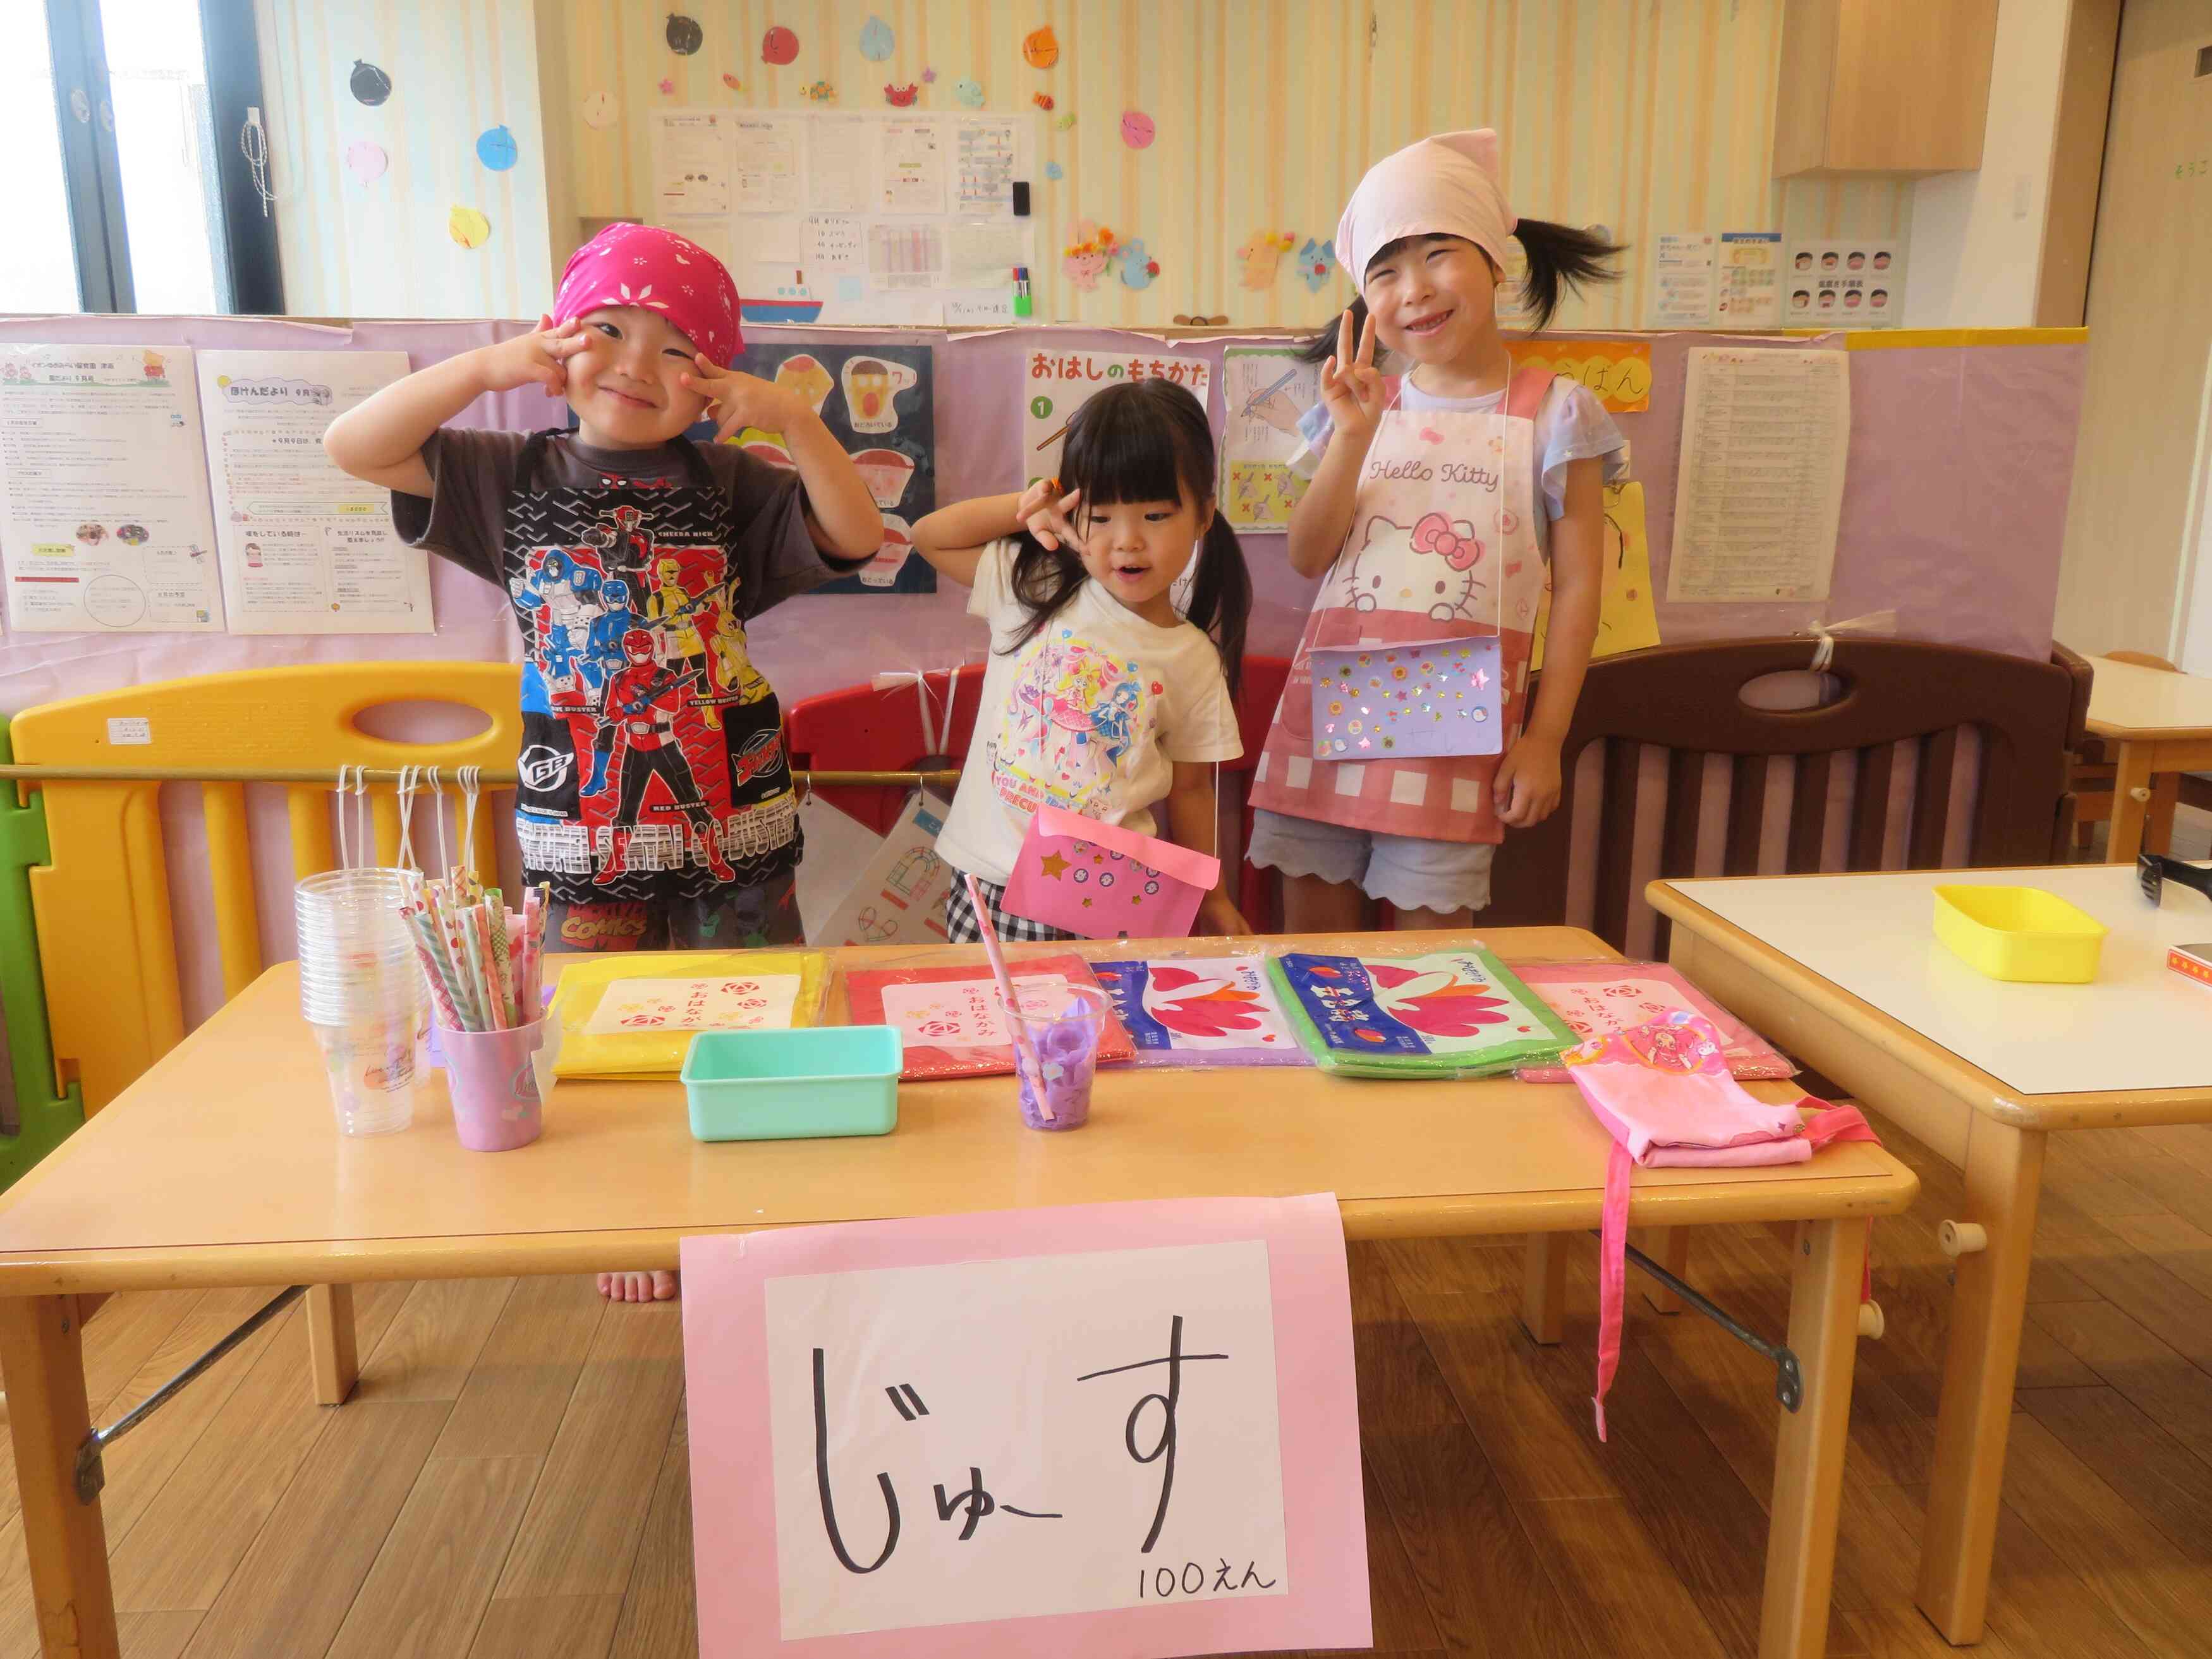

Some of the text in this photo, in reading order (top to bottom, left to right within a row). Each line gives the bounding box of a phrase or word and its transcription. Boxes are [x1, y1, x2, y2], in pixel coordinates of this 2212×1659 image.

[1031, 353, 1209, 386] おはしのもちかた
[1370, 459, 1499, 493] Hello Kitty
[996, 775, 1017, 789] YOU
[653, 801, 707, 811] RED BUSTER
[561, 916, 647, 940] COMICS
[812, 1315, 1229, 1575] じゅーす
[1137, 1557, 1275, 1600] 100えん
